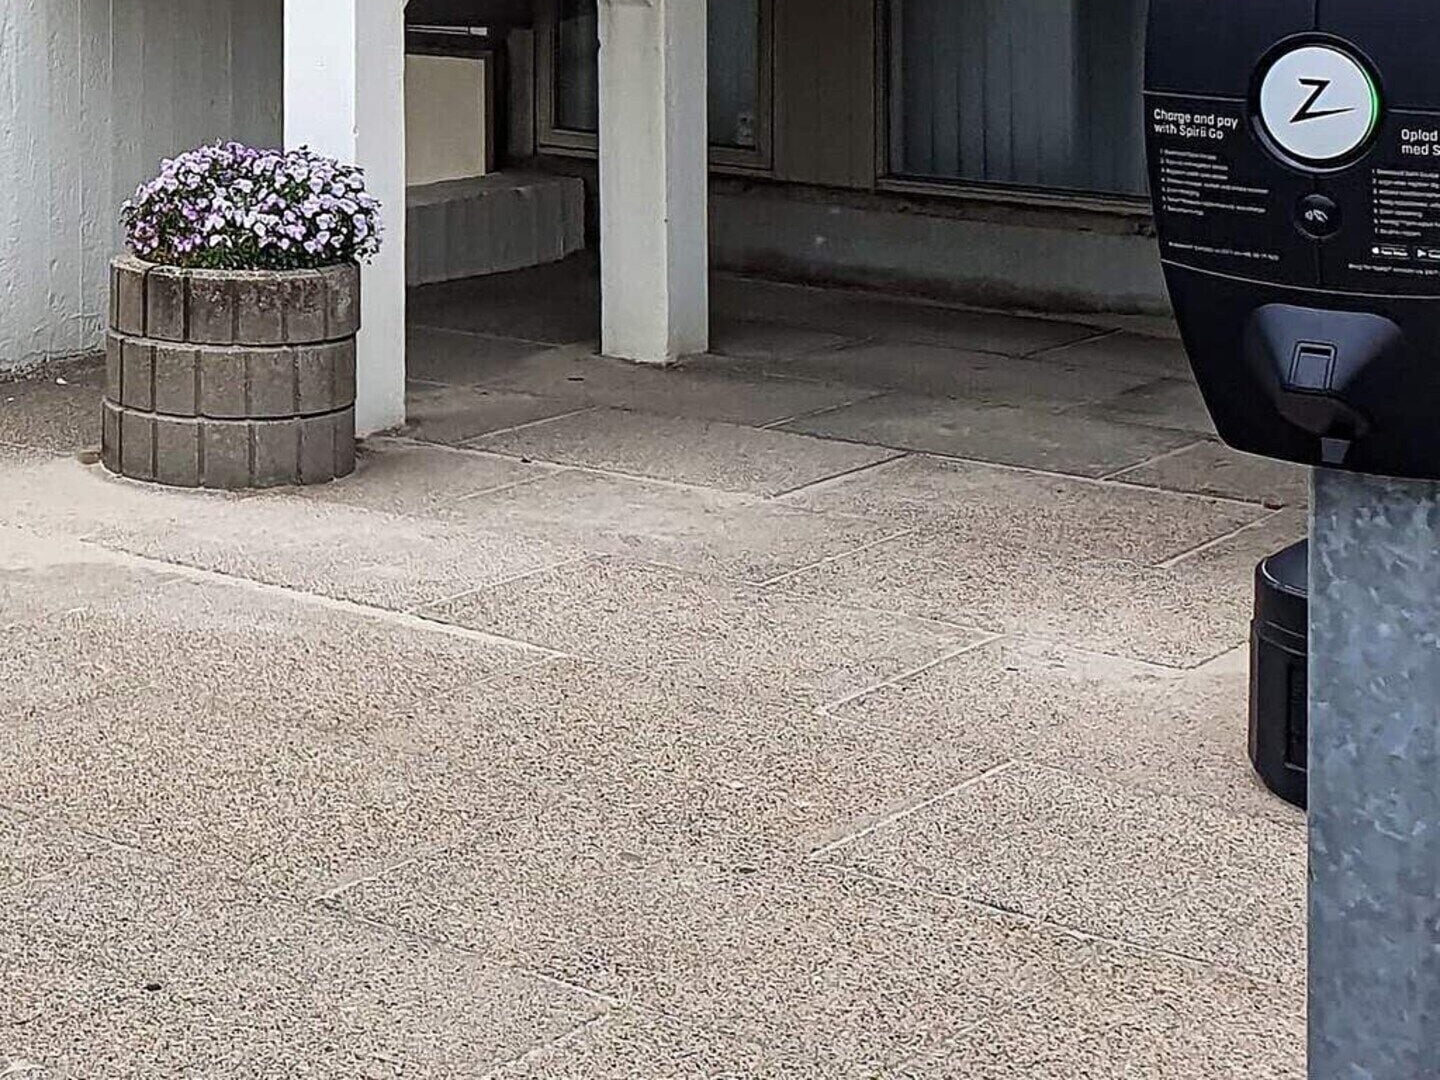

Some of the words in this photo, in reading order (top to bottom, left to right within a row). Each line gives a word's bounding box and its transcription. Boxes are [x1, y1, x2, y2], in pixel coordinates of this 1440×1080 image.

[1153, 107, 1192, 125] Charge
[1193, 113, 1215, 126] and
[1216, 116, 1239, 131] pay
[1153, 123, 1178, 135] with
[1179, 124, 1207, 139] Spirii
[1208, 127, 1224, 140] Go
[1401, 128, 1439, 143] Oplad
[1401, 143, 1430, 156] med
